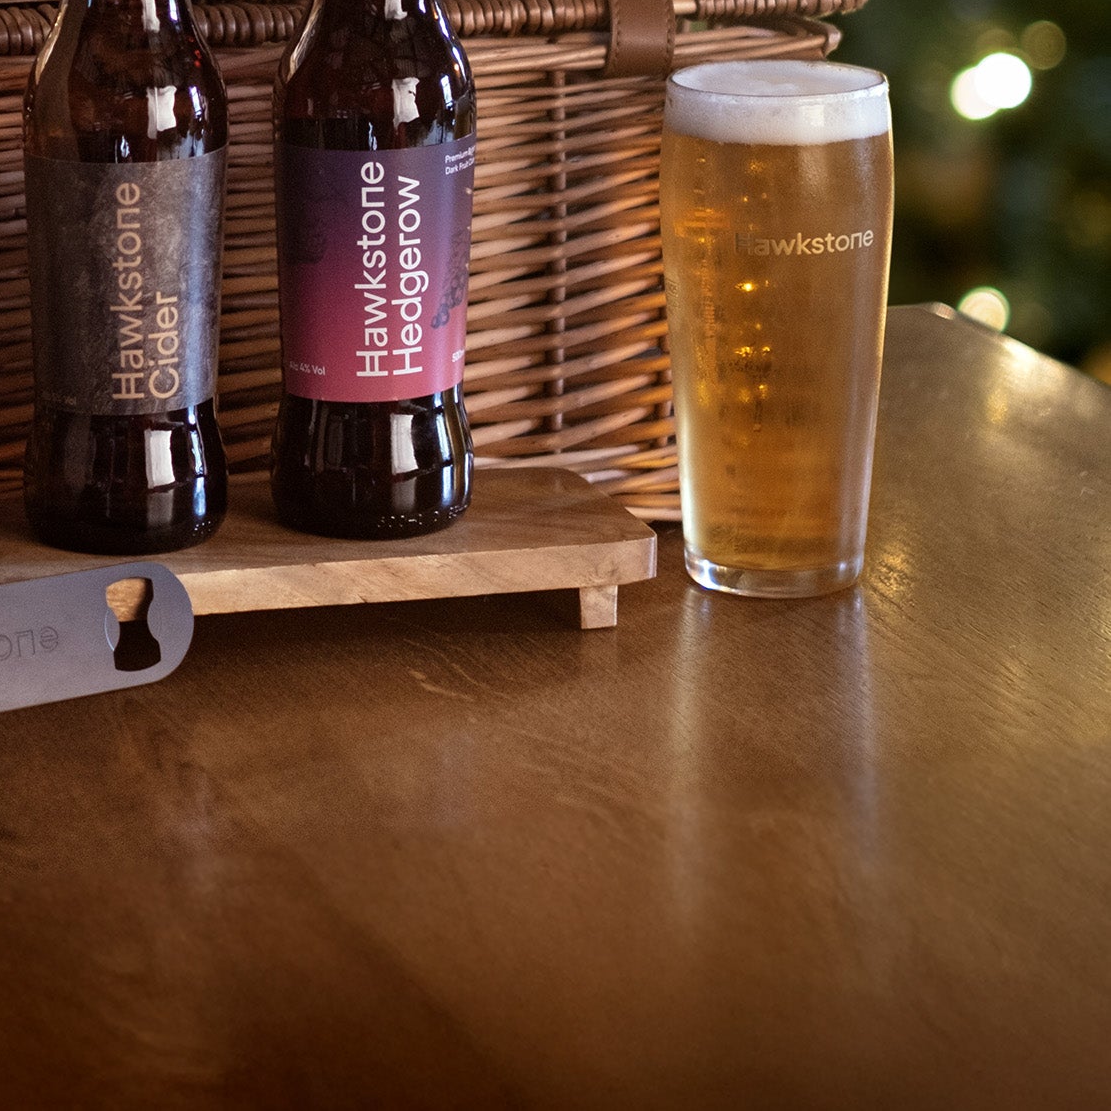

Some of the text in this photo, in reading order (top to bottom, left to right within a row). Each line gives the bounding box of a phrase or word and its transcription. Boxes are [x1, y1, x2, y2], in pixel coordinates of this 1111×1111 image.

[110, 182, 145, 400] Hawkstone
[354, 161, 389, 377] Hawkstone
[391, 176, 429, 376] Hedgerow
[733, 229, 874, 256] Hawkstone
[148, 291, 180, 399] Cider
